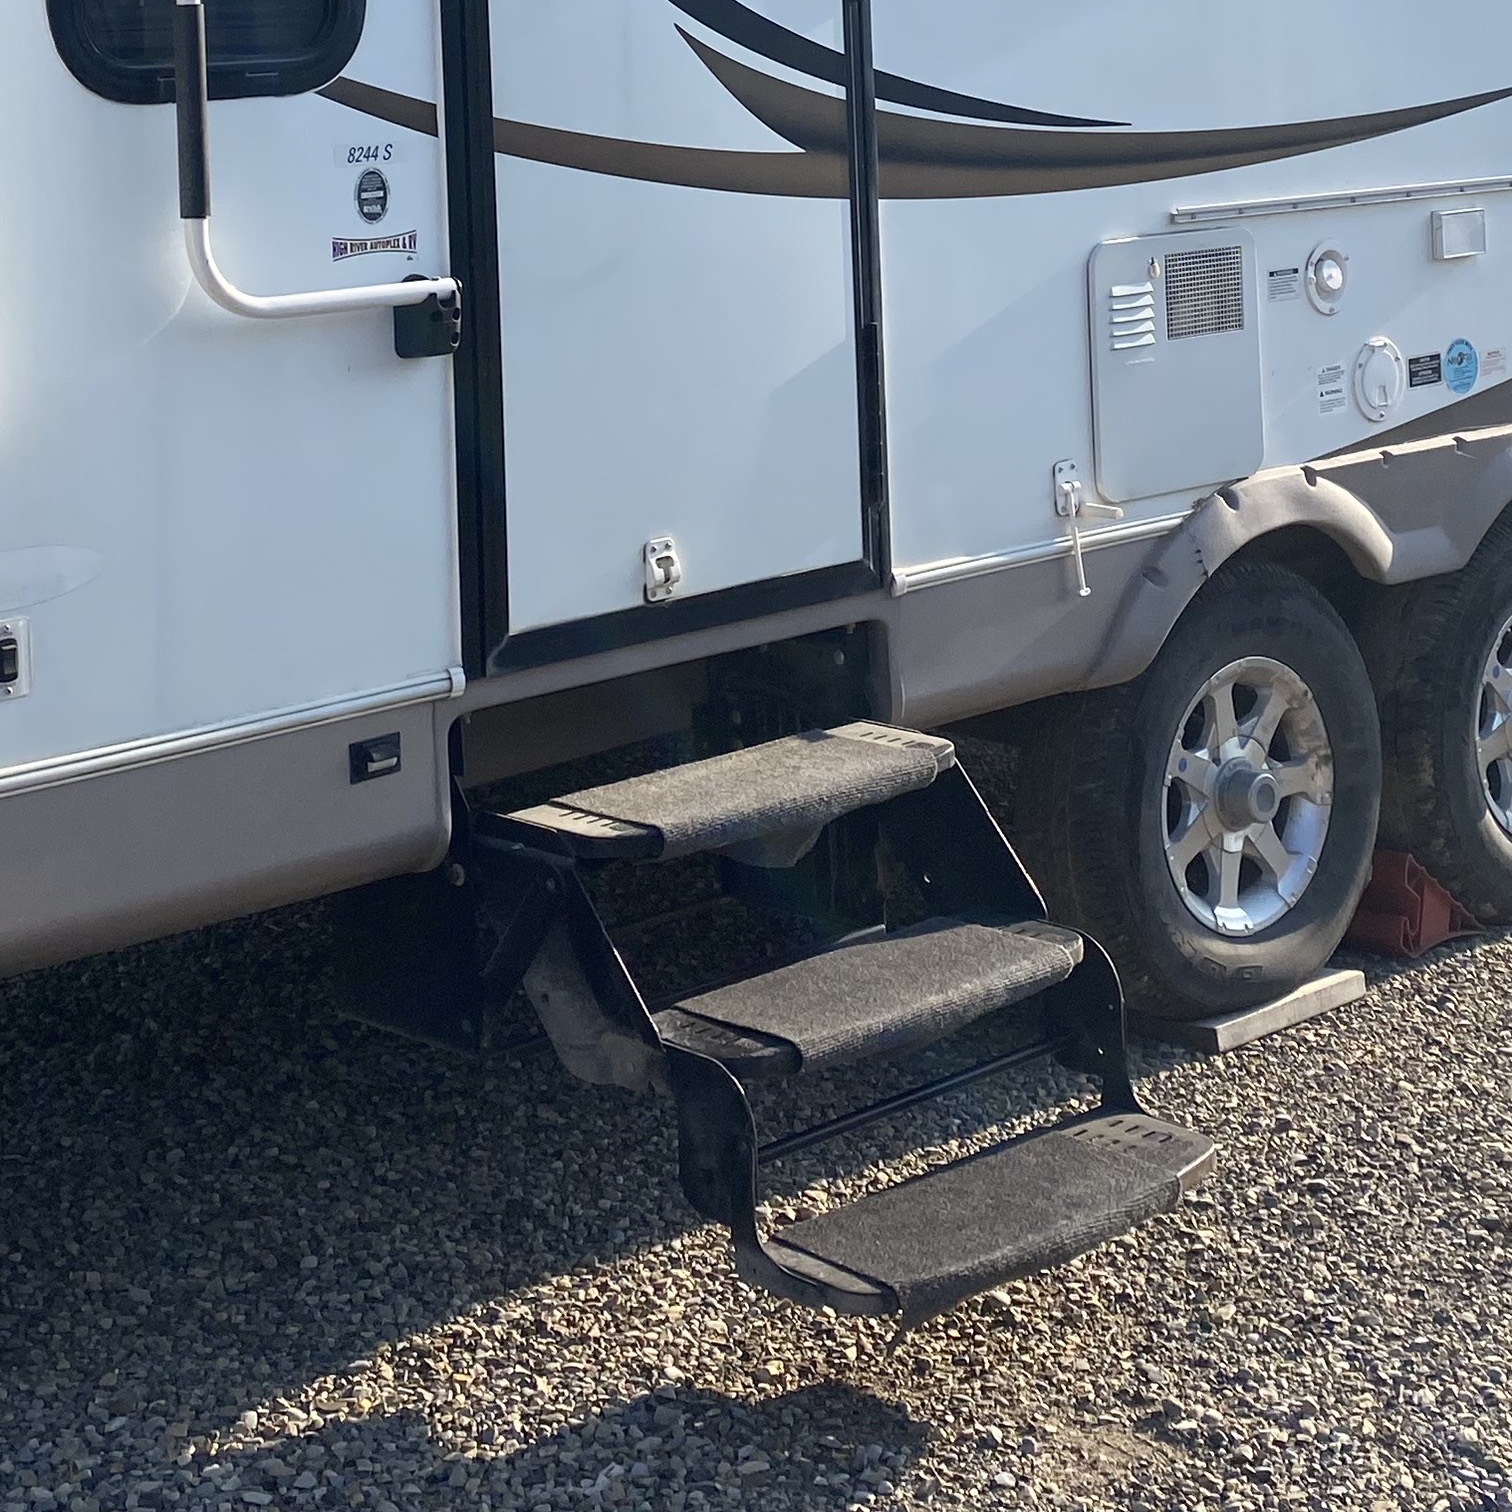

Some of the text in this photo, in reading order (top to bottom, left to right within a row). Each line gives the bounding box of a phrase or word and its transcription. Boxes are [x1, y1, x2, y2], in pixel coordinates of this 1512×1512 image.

[347, 143, 393, 164] 8244 S
[369, 237, 401, 251] AUTOPLEX
